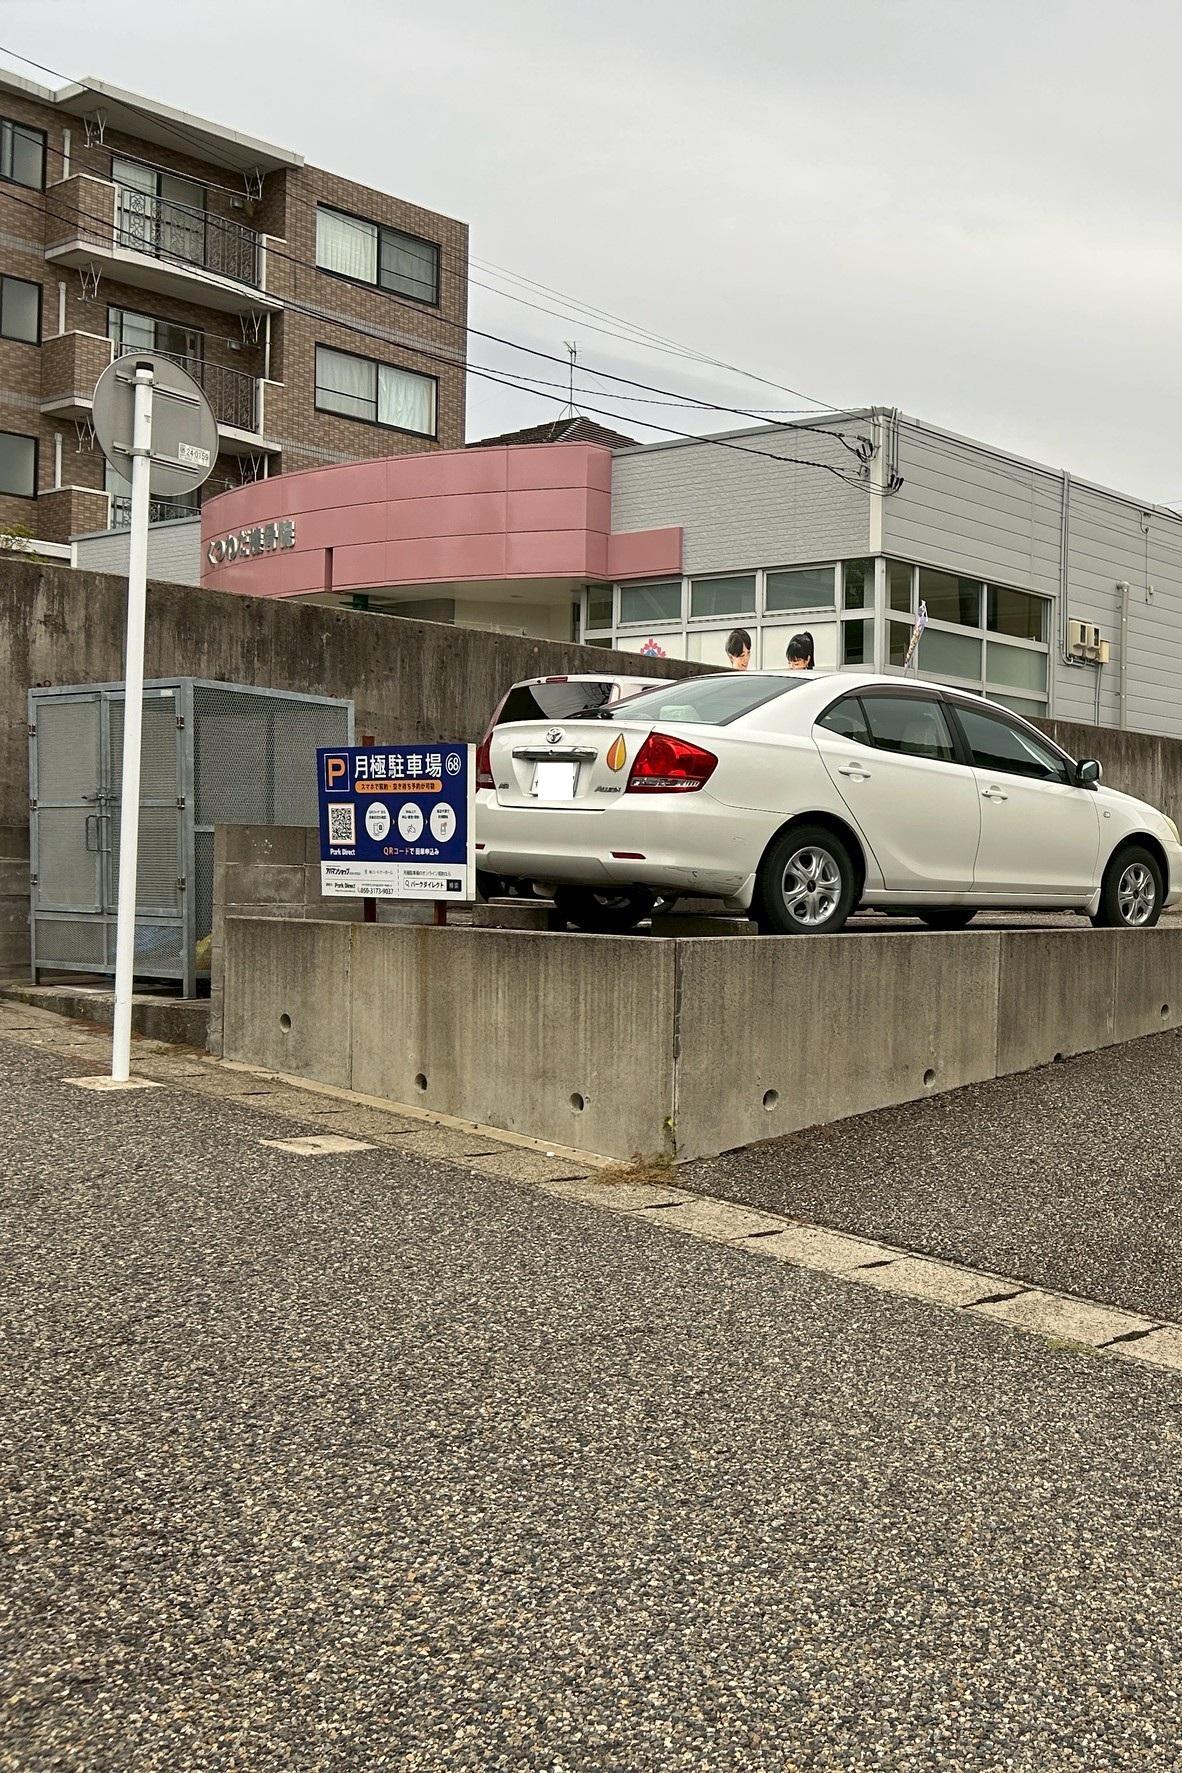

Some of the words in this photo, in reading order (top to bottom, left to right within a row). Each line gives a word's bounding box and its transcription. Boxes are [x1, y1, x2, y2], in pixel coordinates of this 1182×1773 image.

[328, 758, 346, 787] P
[354, 753, 443, 779] 月極駐車場
